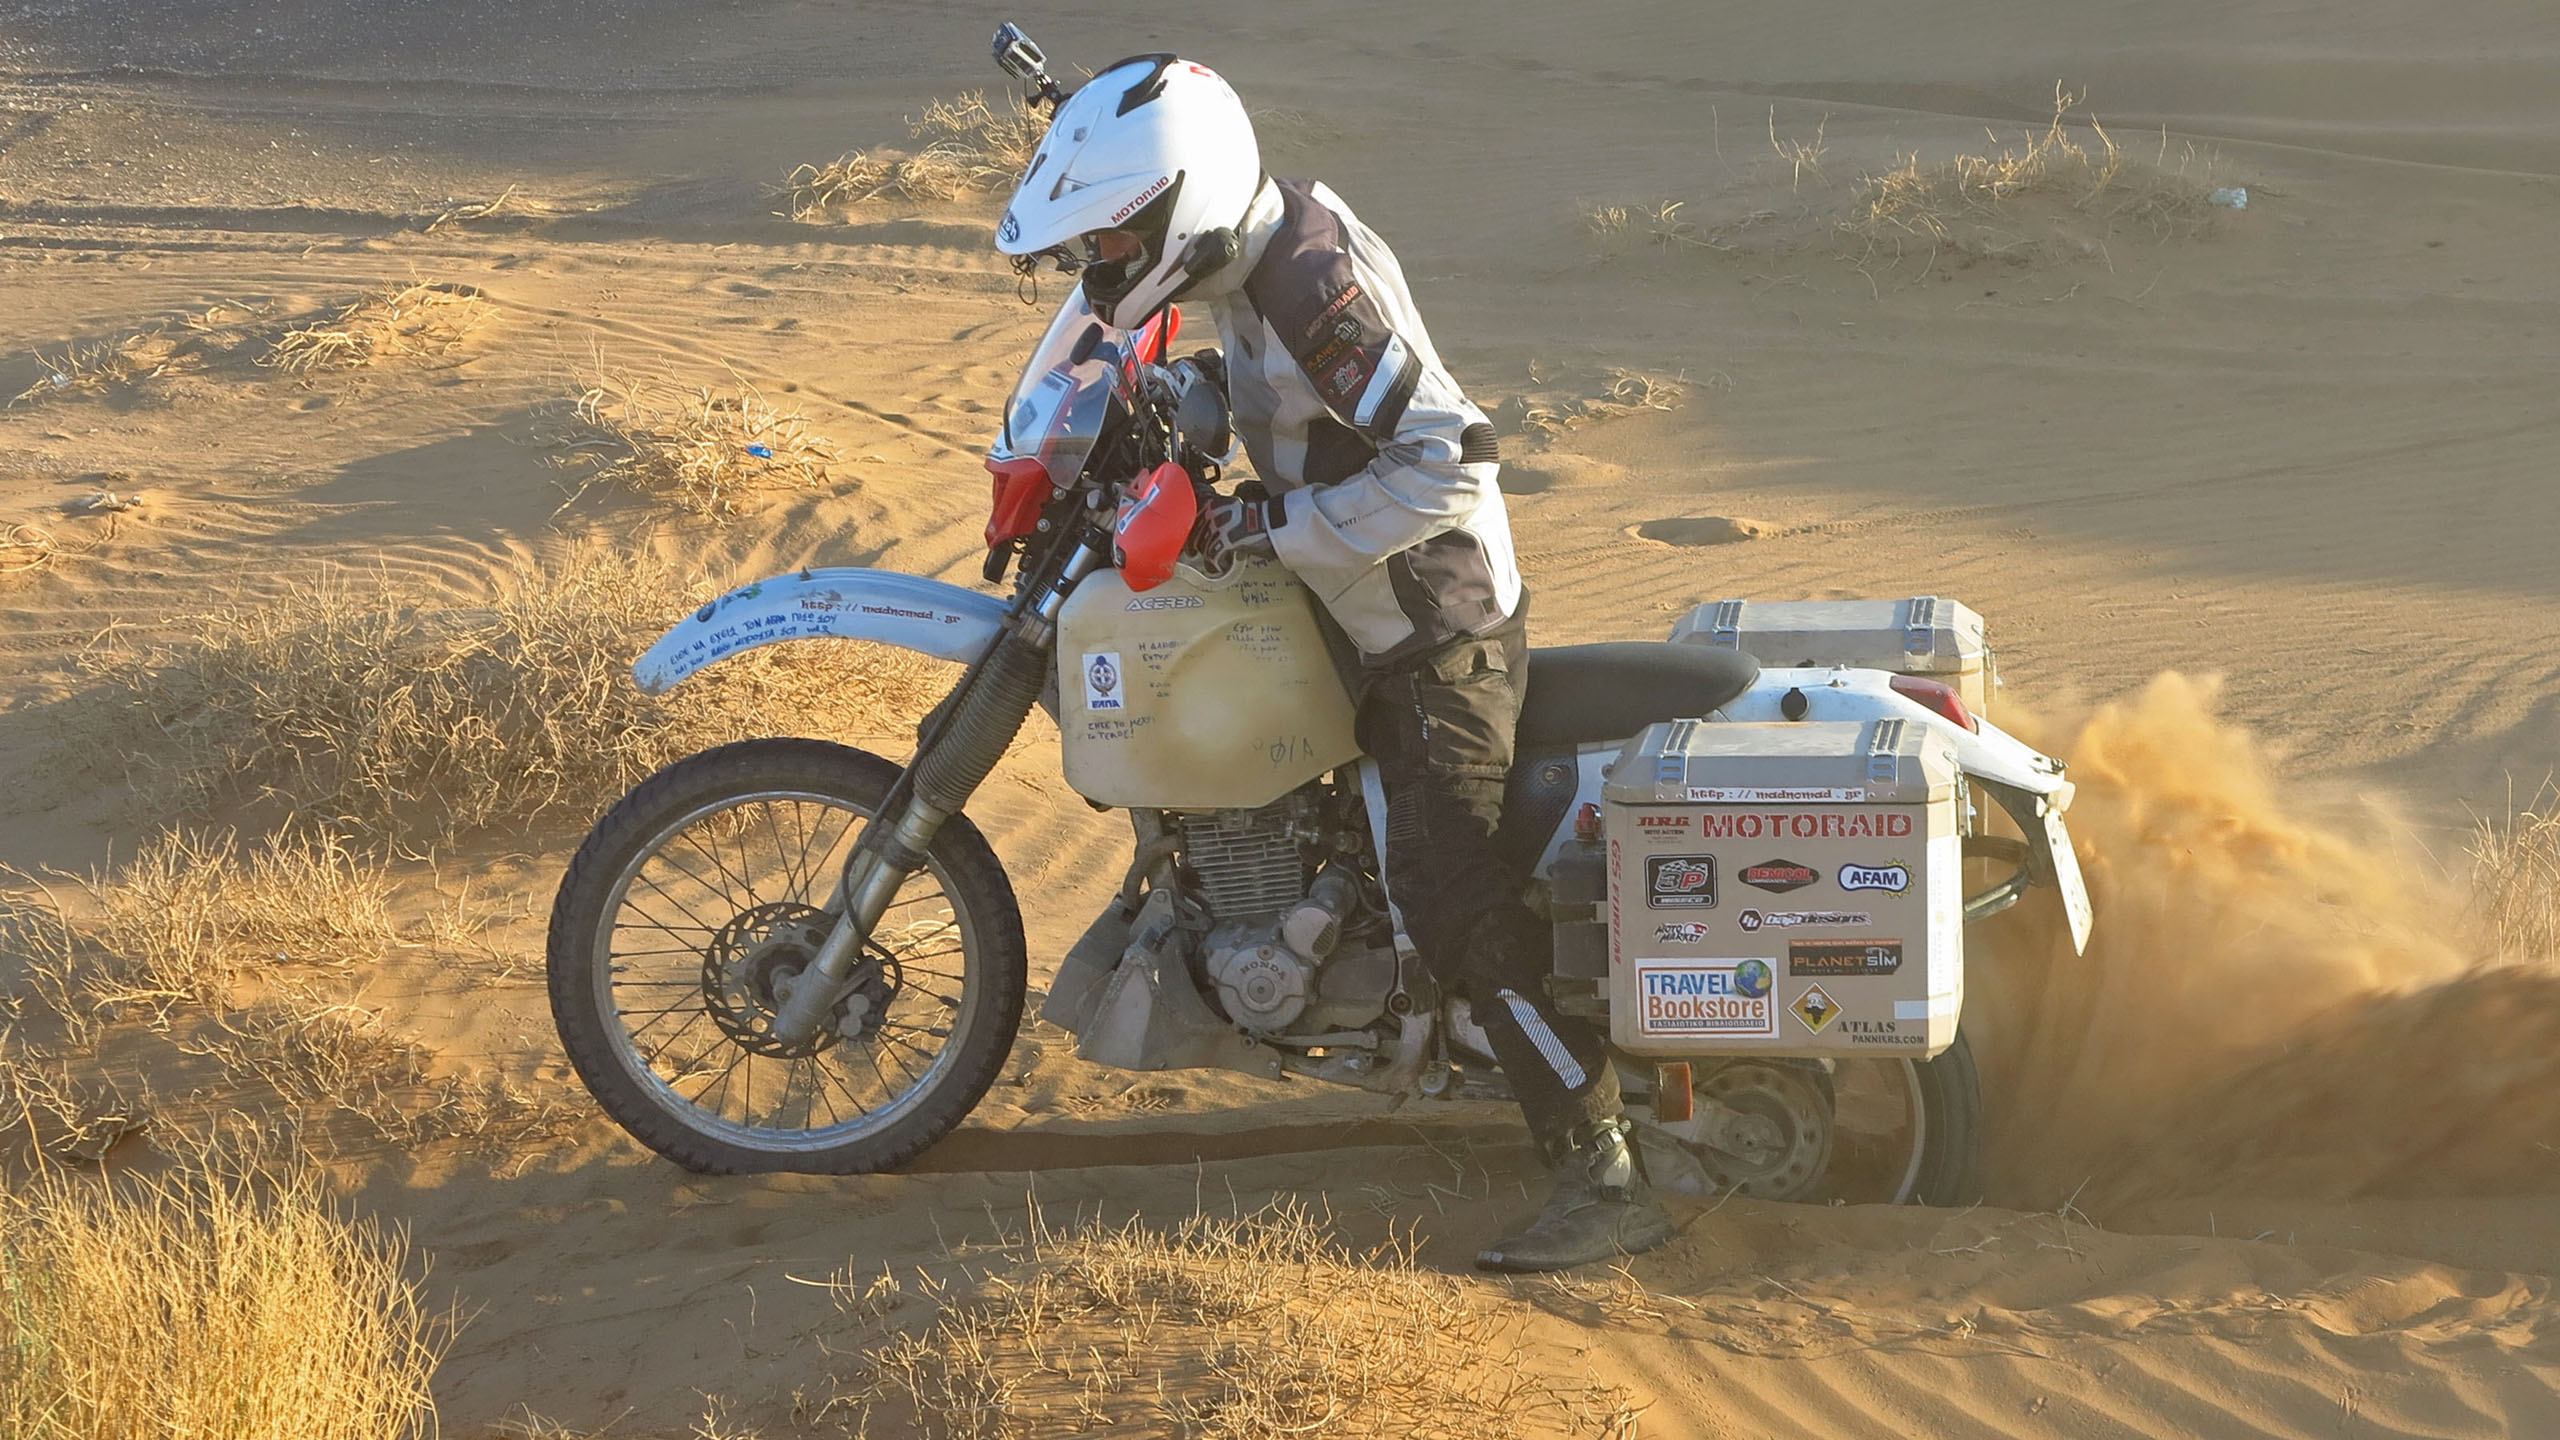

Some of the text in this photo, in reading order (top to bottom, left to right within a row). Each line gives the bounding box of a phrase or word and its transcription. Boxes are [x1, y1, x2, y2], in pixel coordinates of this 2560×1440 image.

[1110, 175, 1169, 224] MOTORAID
[1125, 596, 1205, 611] ACERBIS
[1703, 814, 1912, 838] MOTORAID
[1658, 870, 1705, 890] 3P
[1850, 872, 1899, 886] AFAM
[1240, 961, 1287, 980] HONDA
[1645, 974, 1735, 995] TRAVEL
[1649, 996, 1764, 1018] Bookstore
[1838, 1021, 1896, 1033] ATLAS
